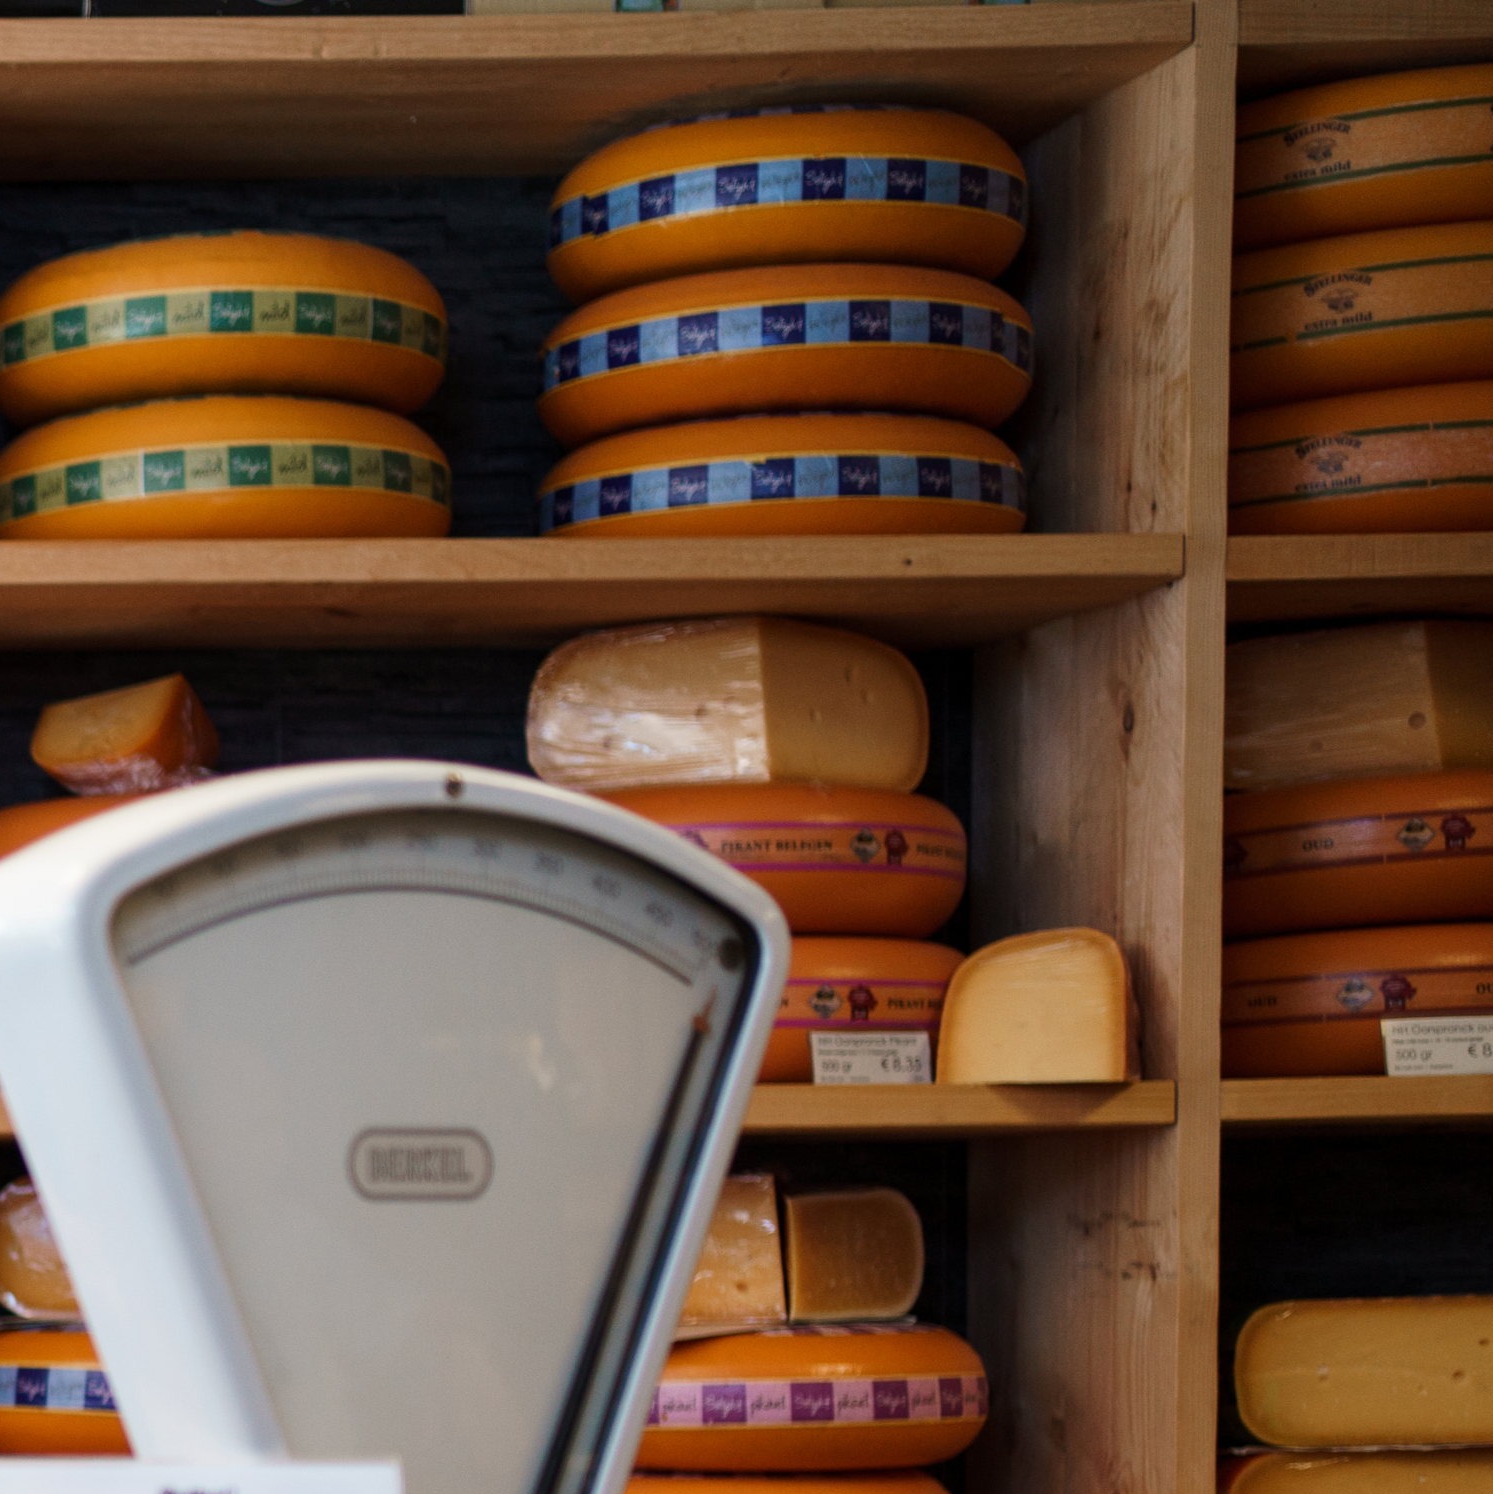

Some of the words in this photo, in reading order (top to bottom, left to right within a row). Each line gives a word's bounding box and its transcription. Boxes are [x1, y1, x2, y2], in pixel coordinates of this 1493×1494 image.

[1284, 169, 1317, 181] extra
[1320, 160, 1351, 175] mild
[1304, 319, 1338, 332] extra
[1341, 312, 1372, 325] mild
[1295, 479, 1325, 493] extra
[1328, 473, 1362, 488] mild
[1303, 838, 1335, 851] OUD
[1468, 1042, 1477, 1058] €
